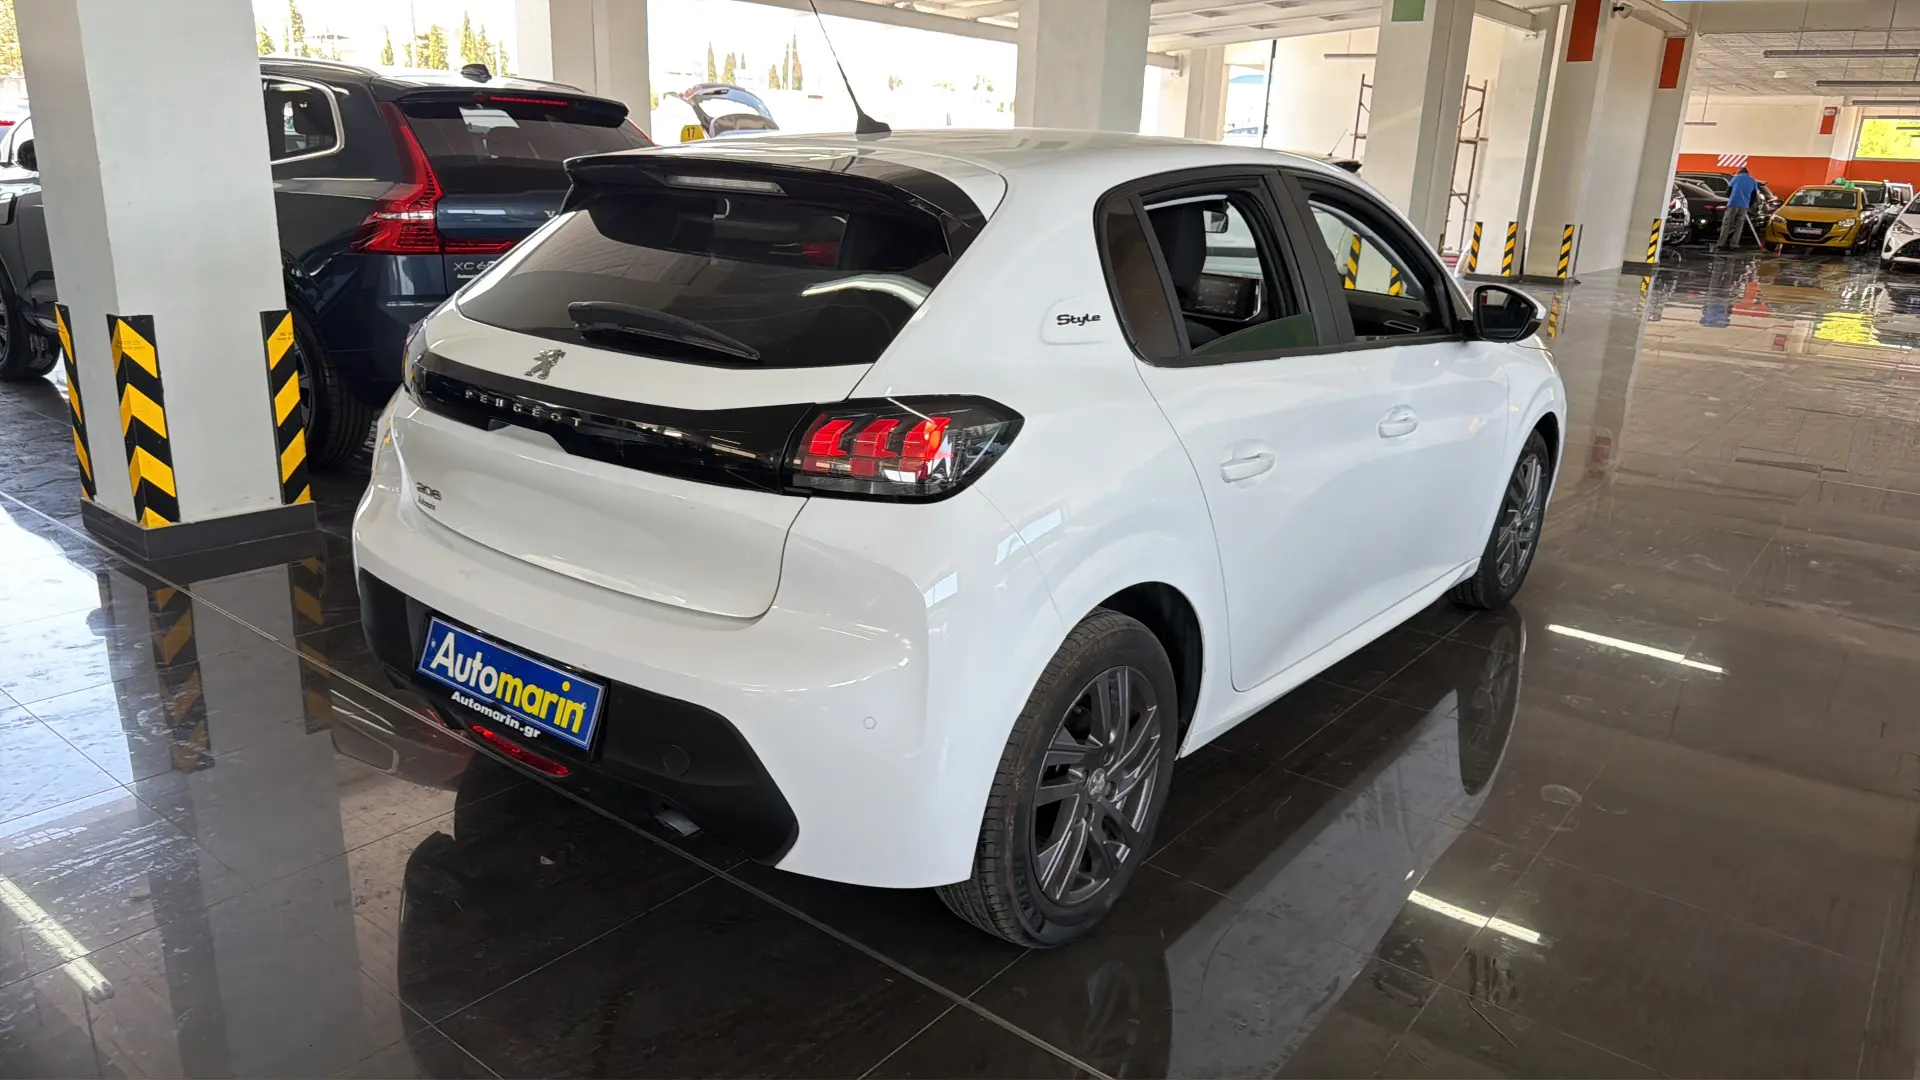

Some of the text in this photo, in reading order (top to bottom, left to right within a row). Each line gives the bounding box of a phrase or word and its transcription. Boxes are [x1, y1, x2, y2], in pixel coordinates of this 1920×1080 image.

[687, 126, 696, 138] 17
[1056, 313, 1101, 326] Style
[465, 389, 581, 427] PEUGEOT
[416, 482, 442, 501] 208
[430, 631, 585, 734] Automarin
[451, 690, 541, 739] Automarin.gr
